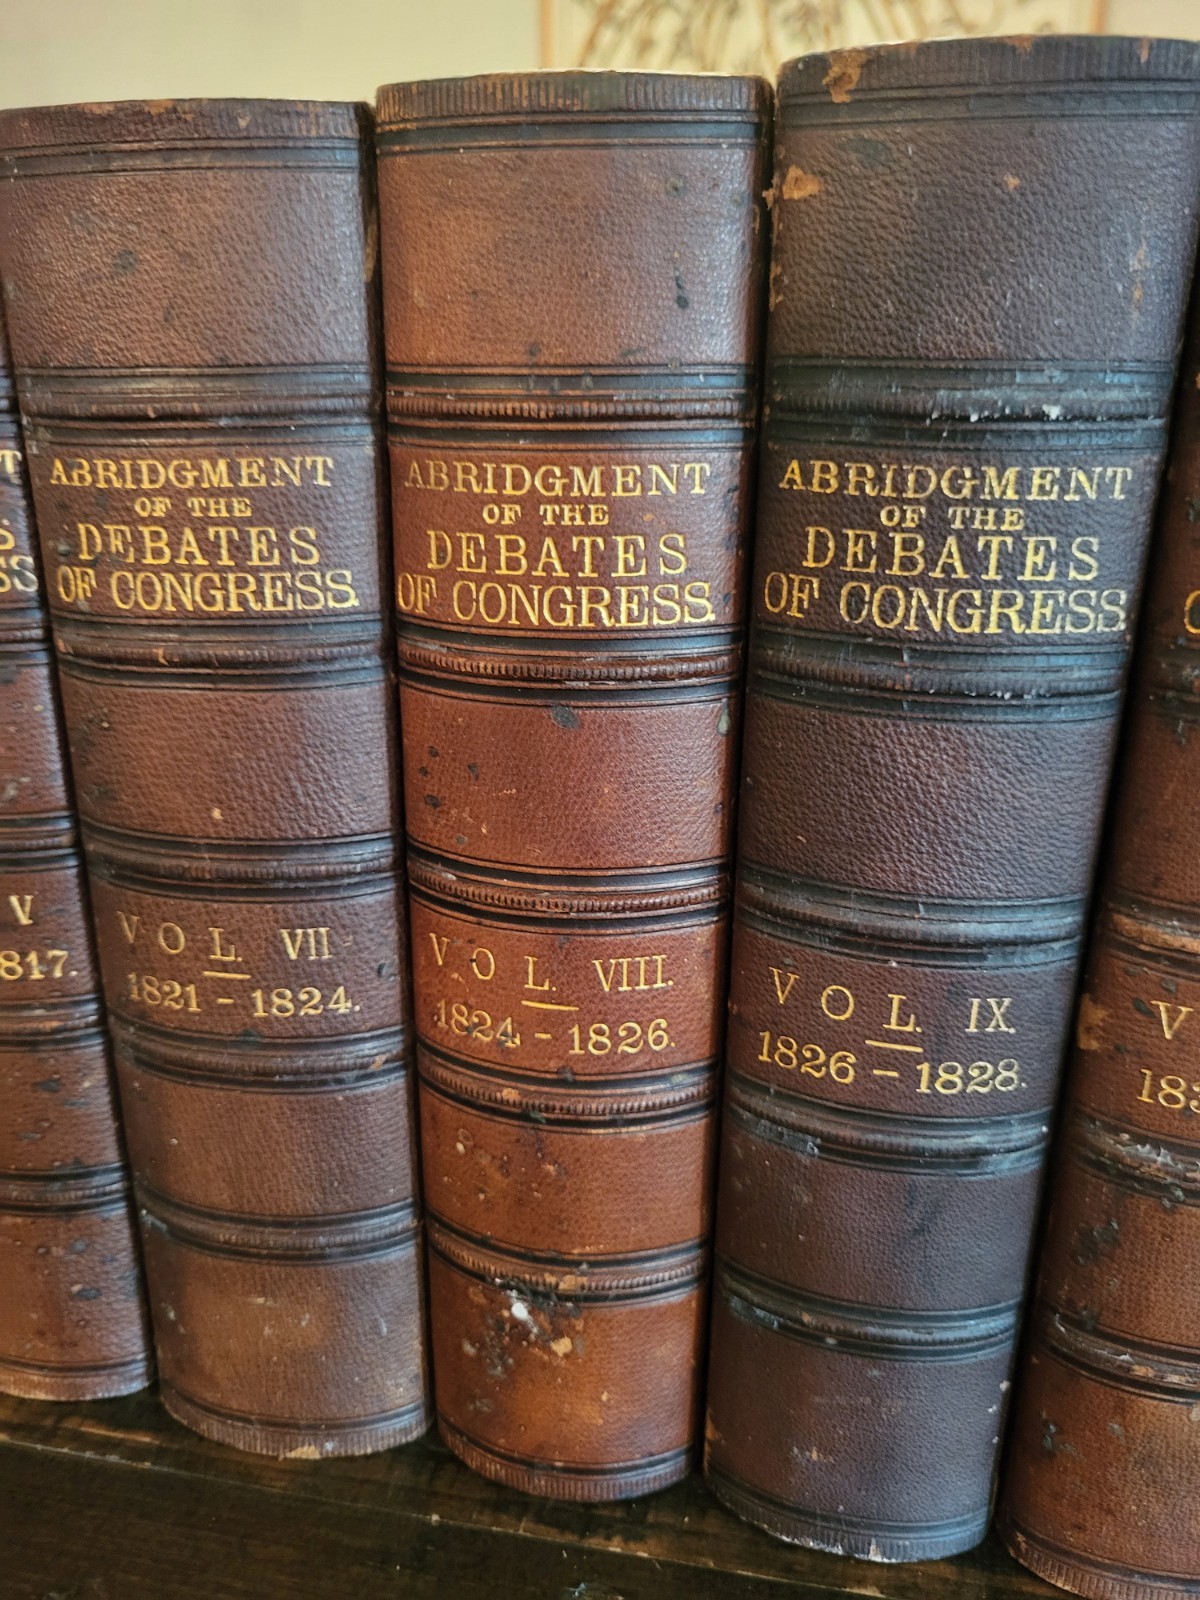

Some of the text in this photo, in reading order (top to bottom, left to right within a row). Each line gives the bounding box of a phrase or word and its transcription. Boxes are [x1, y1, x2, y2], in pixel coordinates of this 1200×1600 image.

[50, 456, 335, 489] ABRIDGMENT
[404, 459, 711, 498] ABRIDGMENT
[779, 459, 1132, 501] ABRIDGMENT
[134, 497, 252, 518] OF THE
[482, 503, 609, 526] OF THE
[879, 504, 1025, 531] OF THE
[77, 522, 320, 567] DEBATES
[427, 530, 687, 578] DEBATES
[802, 526, 1098, 582] DEBATES
[57, 565, 96, 603] OF
[397, 573, 437, 615] OF
[764, 571, 820, 619] OF
[592, 954, 675, 992] VIII.
